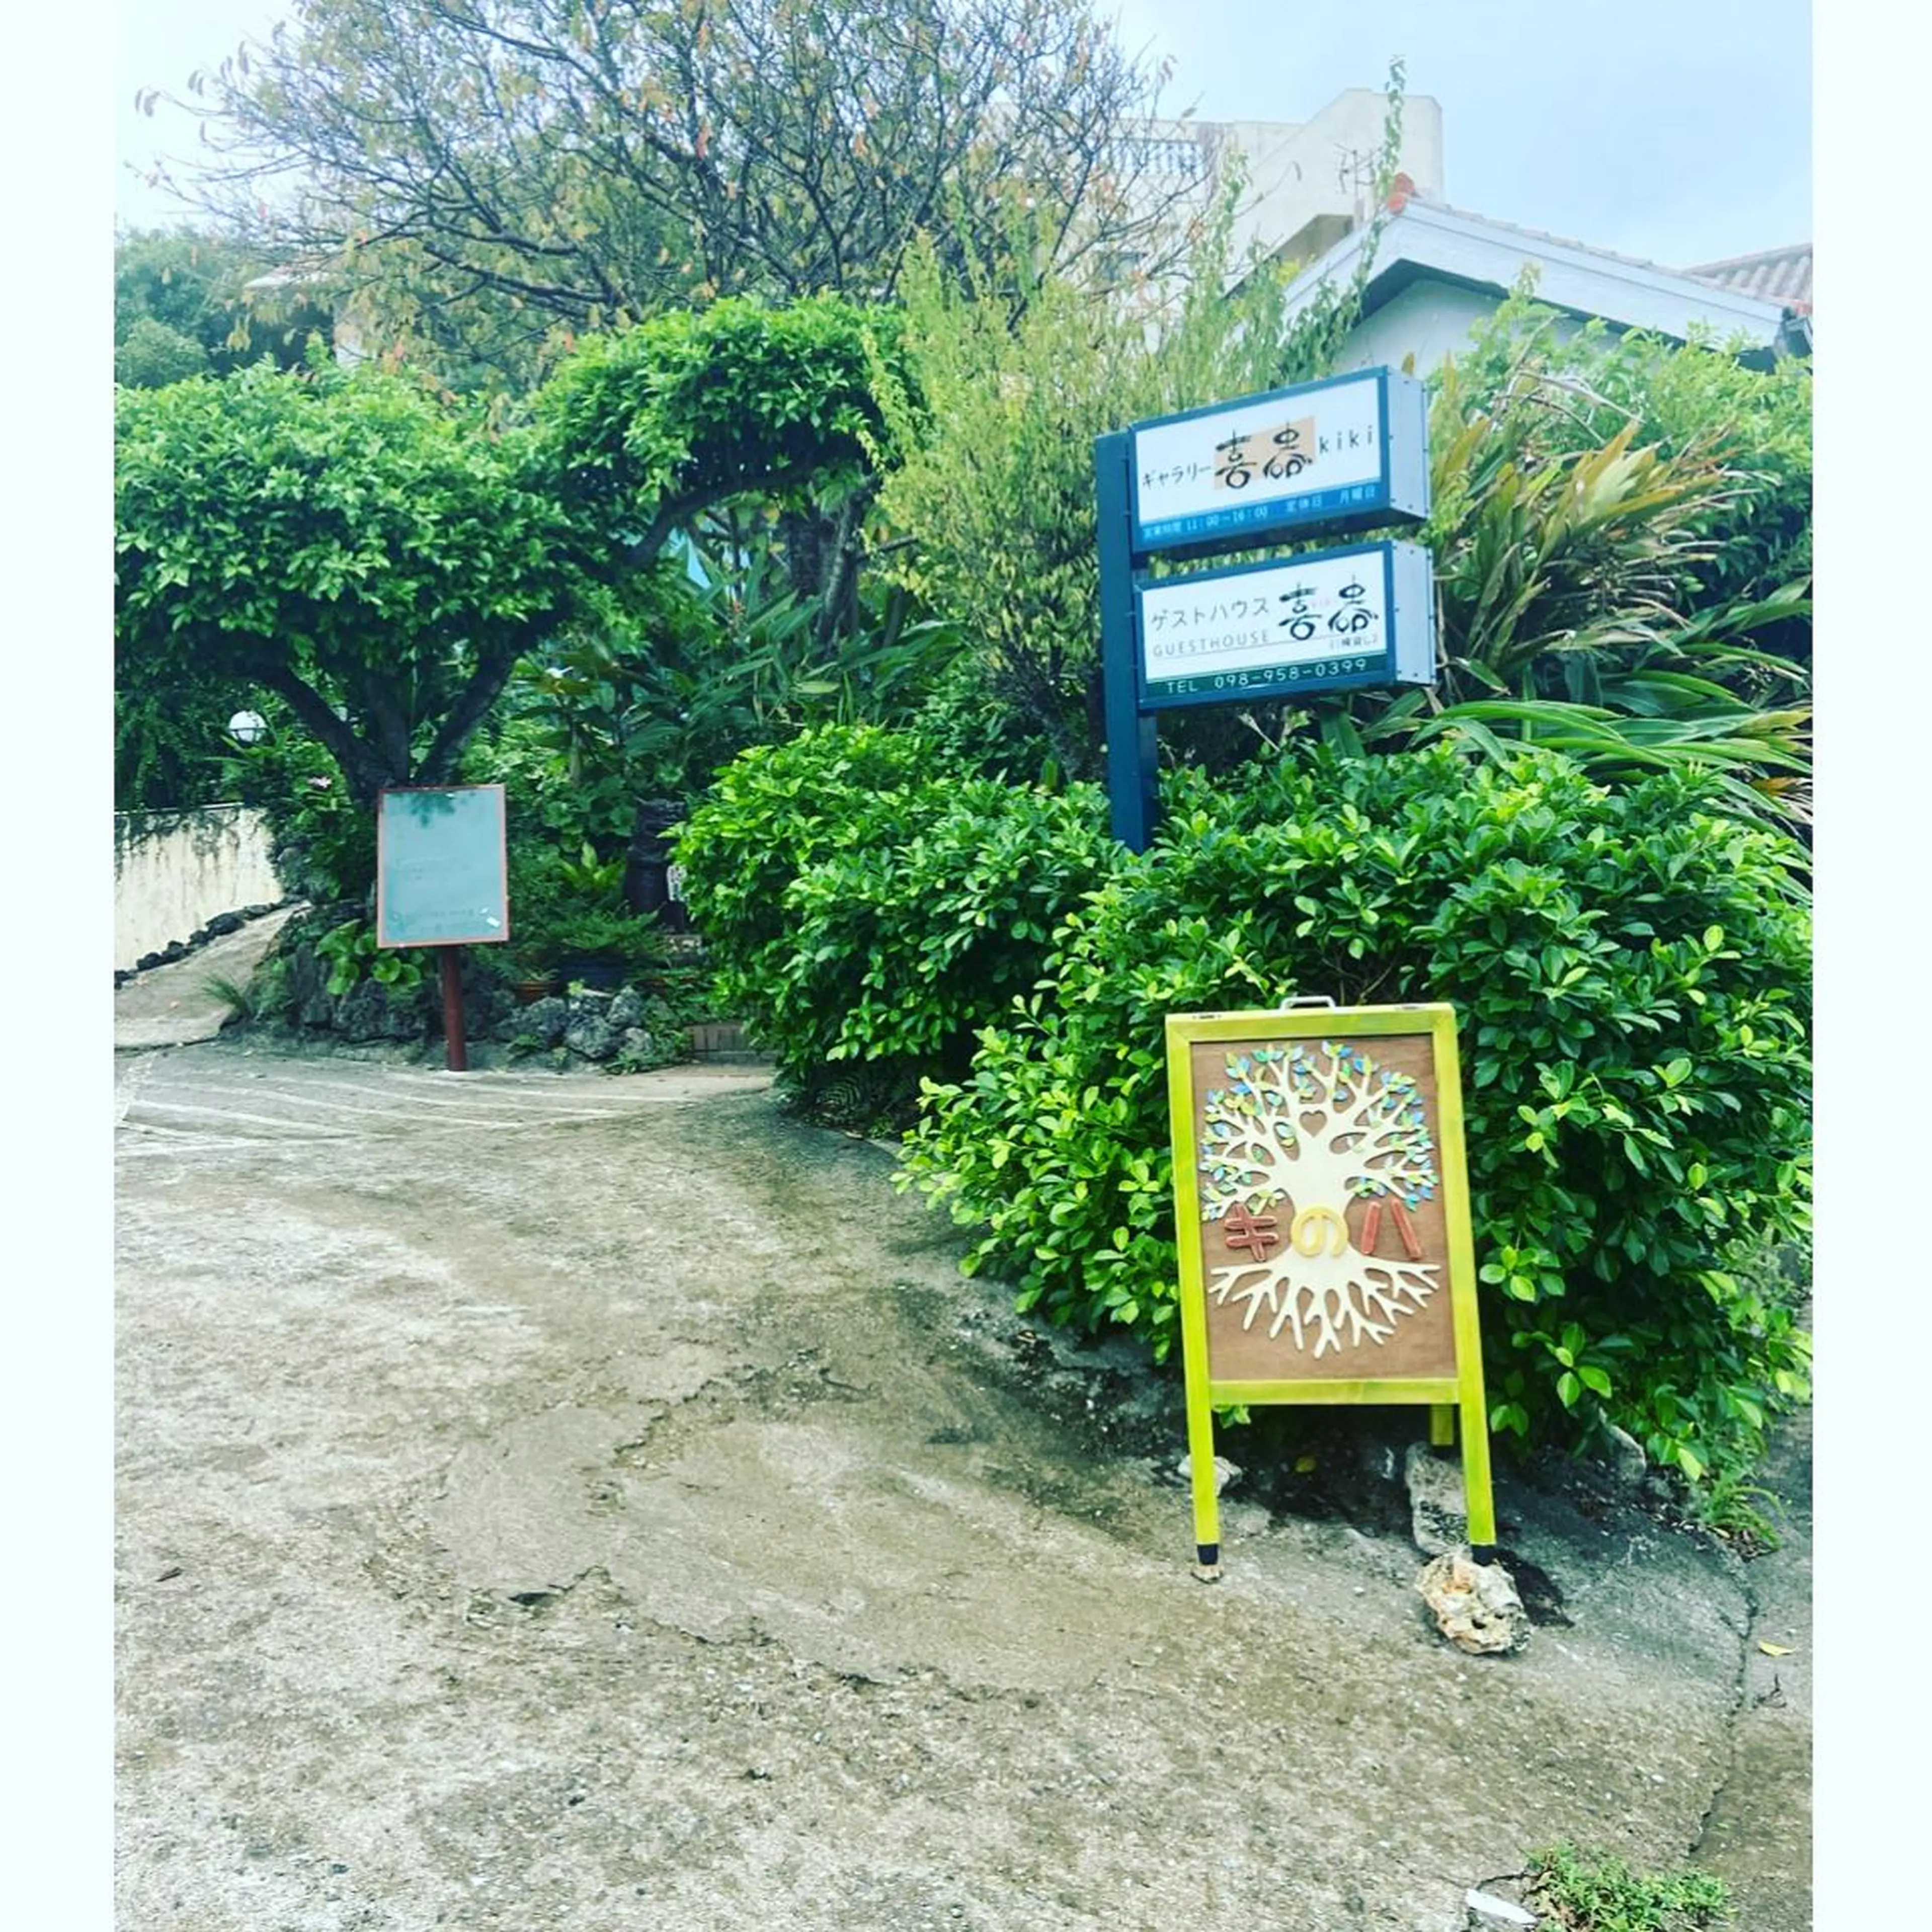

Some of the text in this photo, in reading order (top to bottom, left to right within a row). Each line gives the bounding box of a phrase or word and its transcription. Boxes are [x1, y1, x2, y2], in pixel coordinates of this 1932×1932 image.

[1142, 462, 1212, 490] ギャラリー
[1319, 424, 1373, 454] kiki
[1151, 597, 1269, 631] ゲストハウス
[1153, 628, 1269, 658] GUESTHOUSE
[1166, 658, 1367, 694] TEL 098-958-0399
